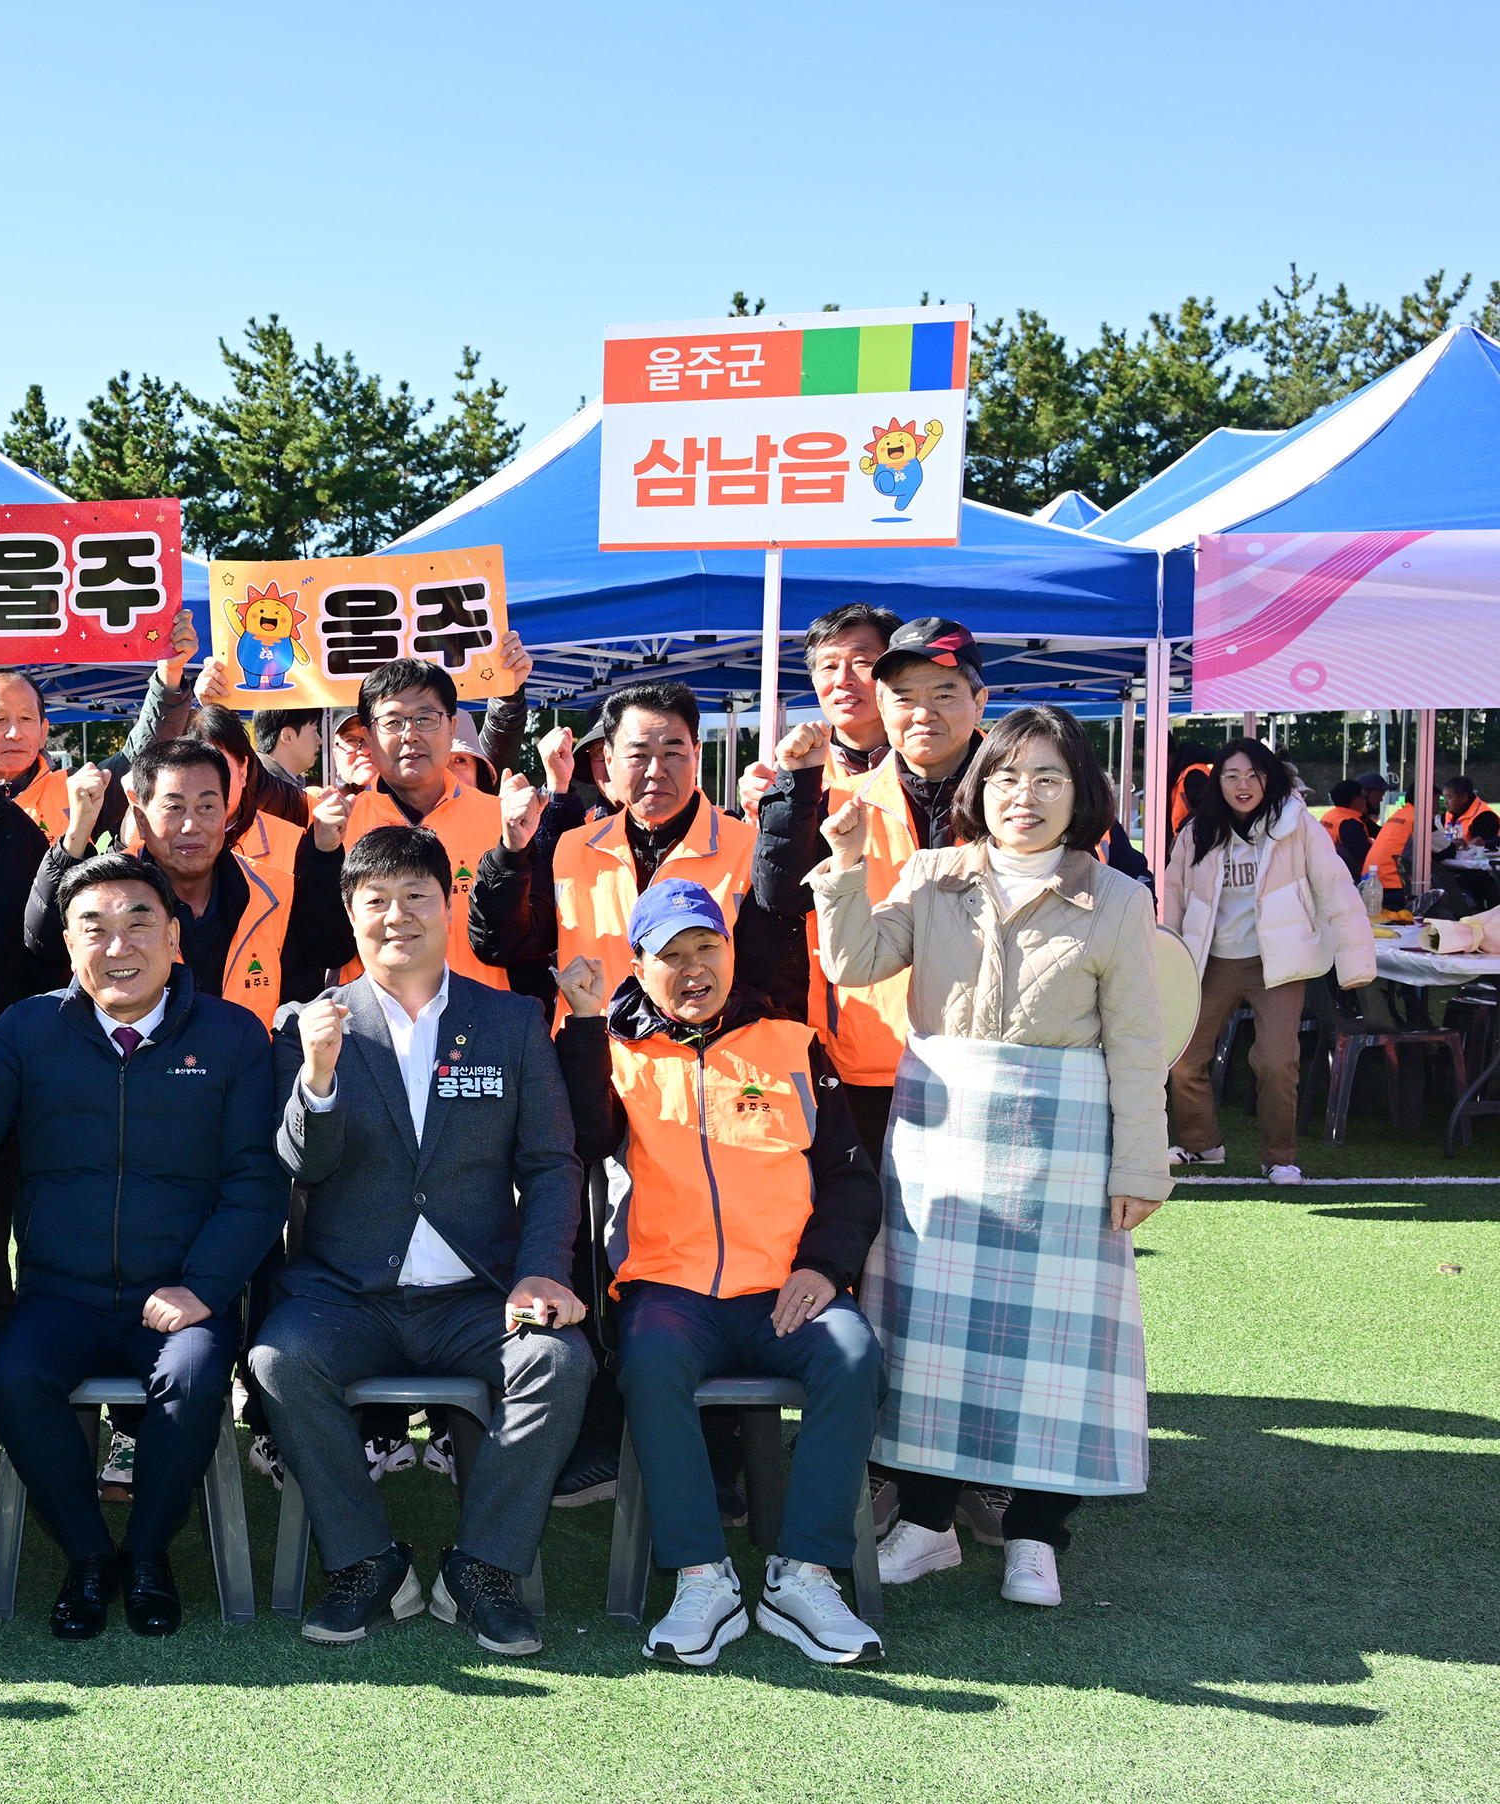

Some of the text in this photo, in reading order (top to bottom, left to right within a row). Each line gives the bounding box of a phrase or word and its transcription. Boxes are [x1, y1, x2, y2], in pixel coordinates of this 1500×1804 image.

[644, 343, 767, 392] 울주군
[632, 431, 852, 508] 삼남읍
[318, 579, 495, 677] 울주
[452, 884, 469, 893] 울주
[244, 976, 270, 989] 울주군
[450, 1065, 496, 1077] 울산시의원
[437, 1077, 504, 1098] 공진혁
[736, 1102, 771, 1113] 울주군
